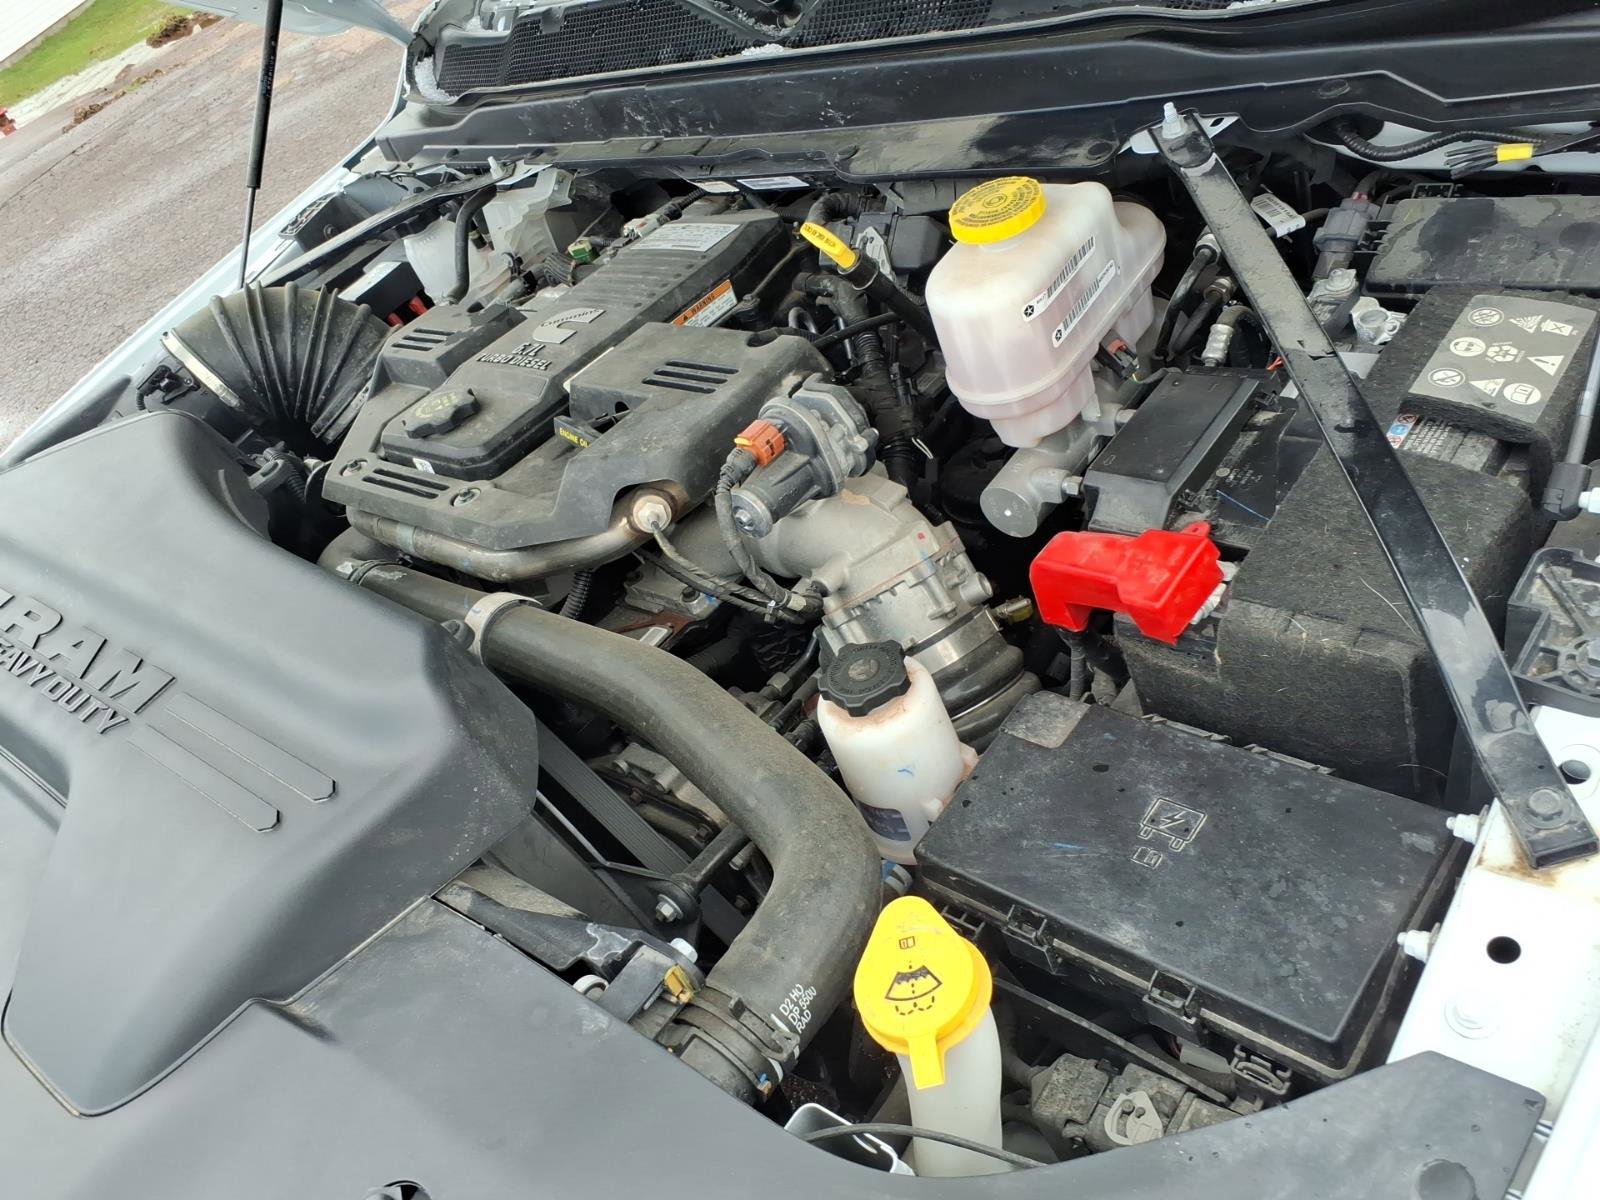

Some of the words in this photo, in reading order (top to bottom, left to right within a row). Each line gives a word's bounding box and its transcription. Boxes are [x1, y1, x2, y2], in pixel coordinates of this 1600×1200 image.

[508, 356, 553, 371] DIESEL
[0, 595, 176, 714] RAM
[779, 997, 795, 1017] D2
[788, 1005, 801, 1026] DP
[795, 1009, 812, 1034] RAD
